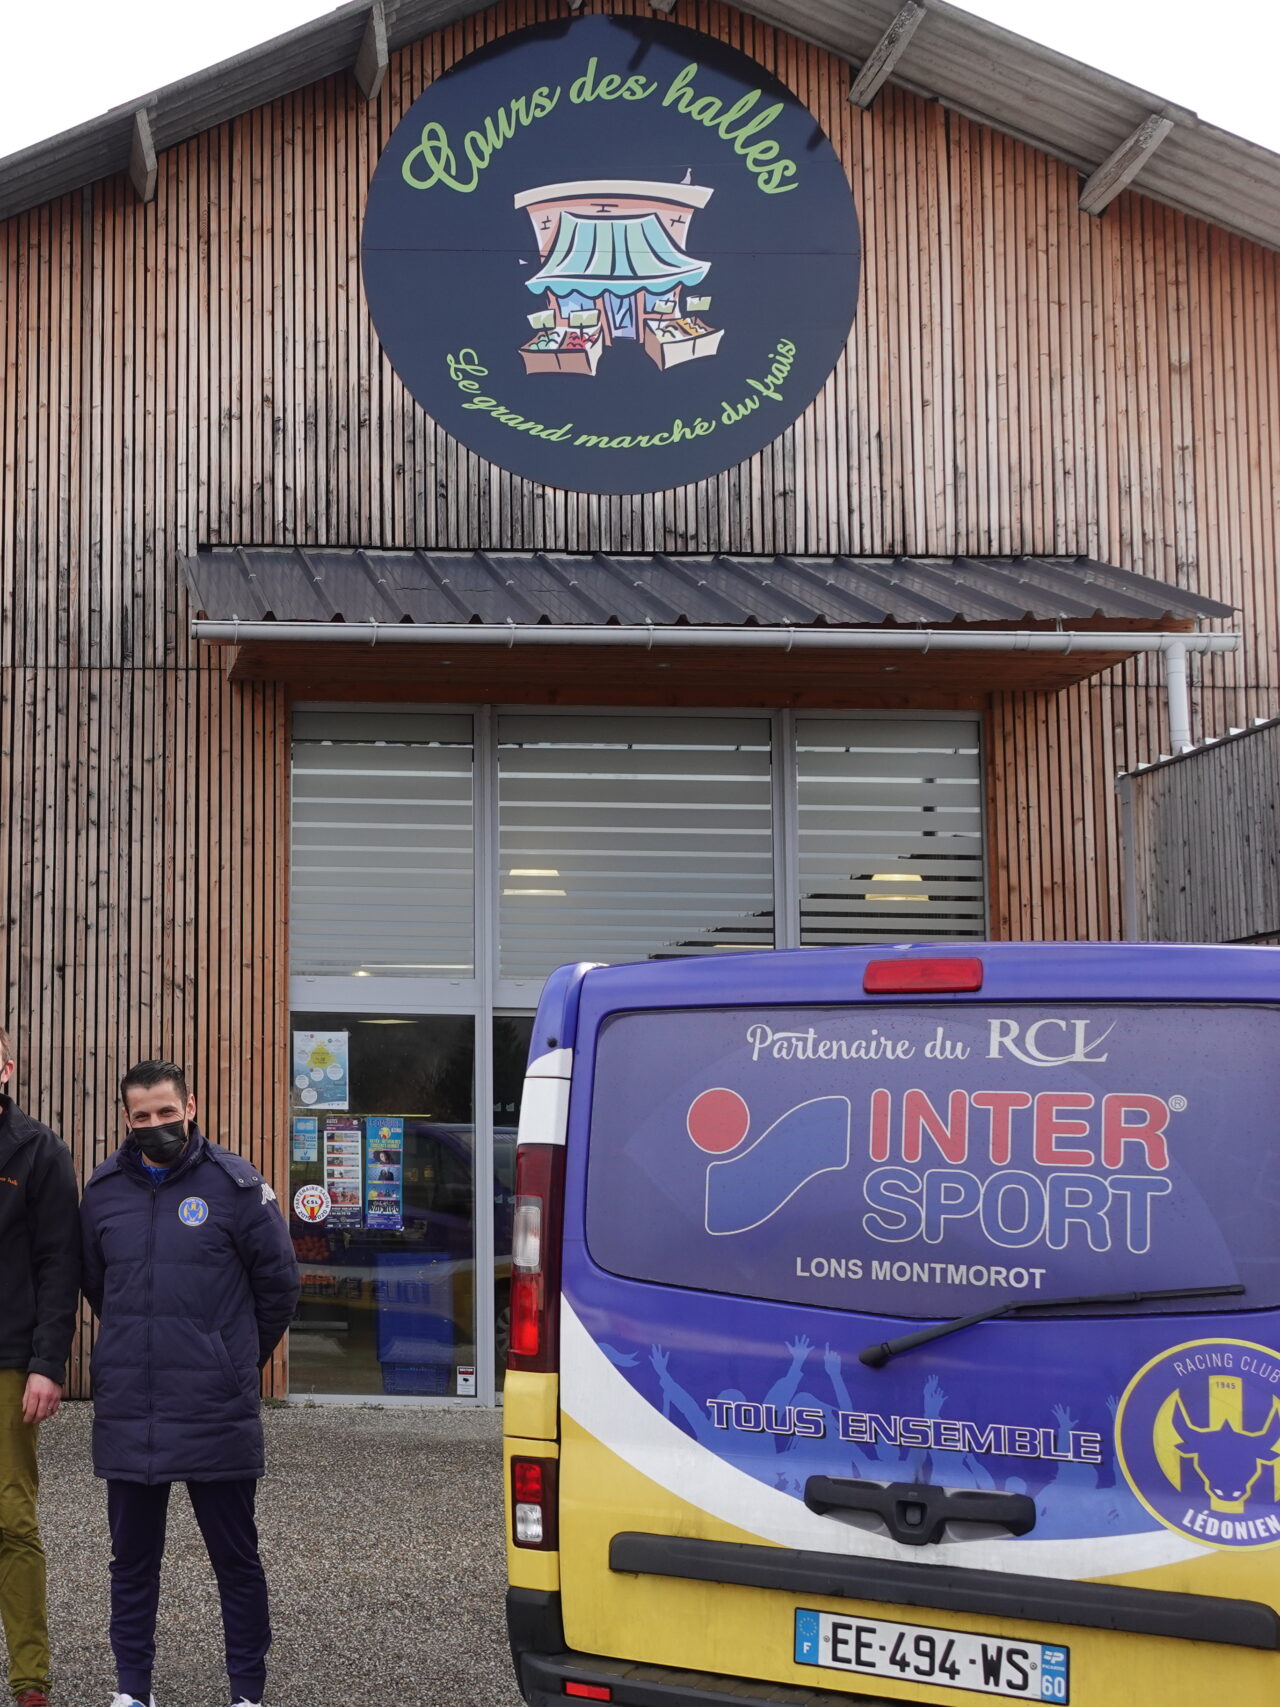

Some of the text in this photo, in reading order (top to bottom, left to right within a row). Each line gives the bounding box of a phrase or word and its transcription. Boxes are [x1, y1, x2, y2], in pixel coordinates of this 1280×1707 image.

[402, 56, 799, 194] Cours des halles
[447, 338, 797, 449] Le grand marché du frais
[746, 1018, 1118, 1067] Partenaire du RCL
[869, 1088, 1170, 1171] INTER
[862, 1166, 1172, 1254] SPORT
[796, 1257, 1047, 1289] LONS MONTMOROT
[1173, 1353, 1280, 1383] RACING CLUB
[1215, 1380, 1236, 1390] 1945
[706, 1398, 1103, 1464] TOUS ENSEMBLE
[1182, 1508, 1280, 1540] LÉDONIEN
[803, 1642, 812, 1654] F
[831, 1621, 1029, 1692] EE-494-WS
[1041, 1675, 1066, 1698] 60
